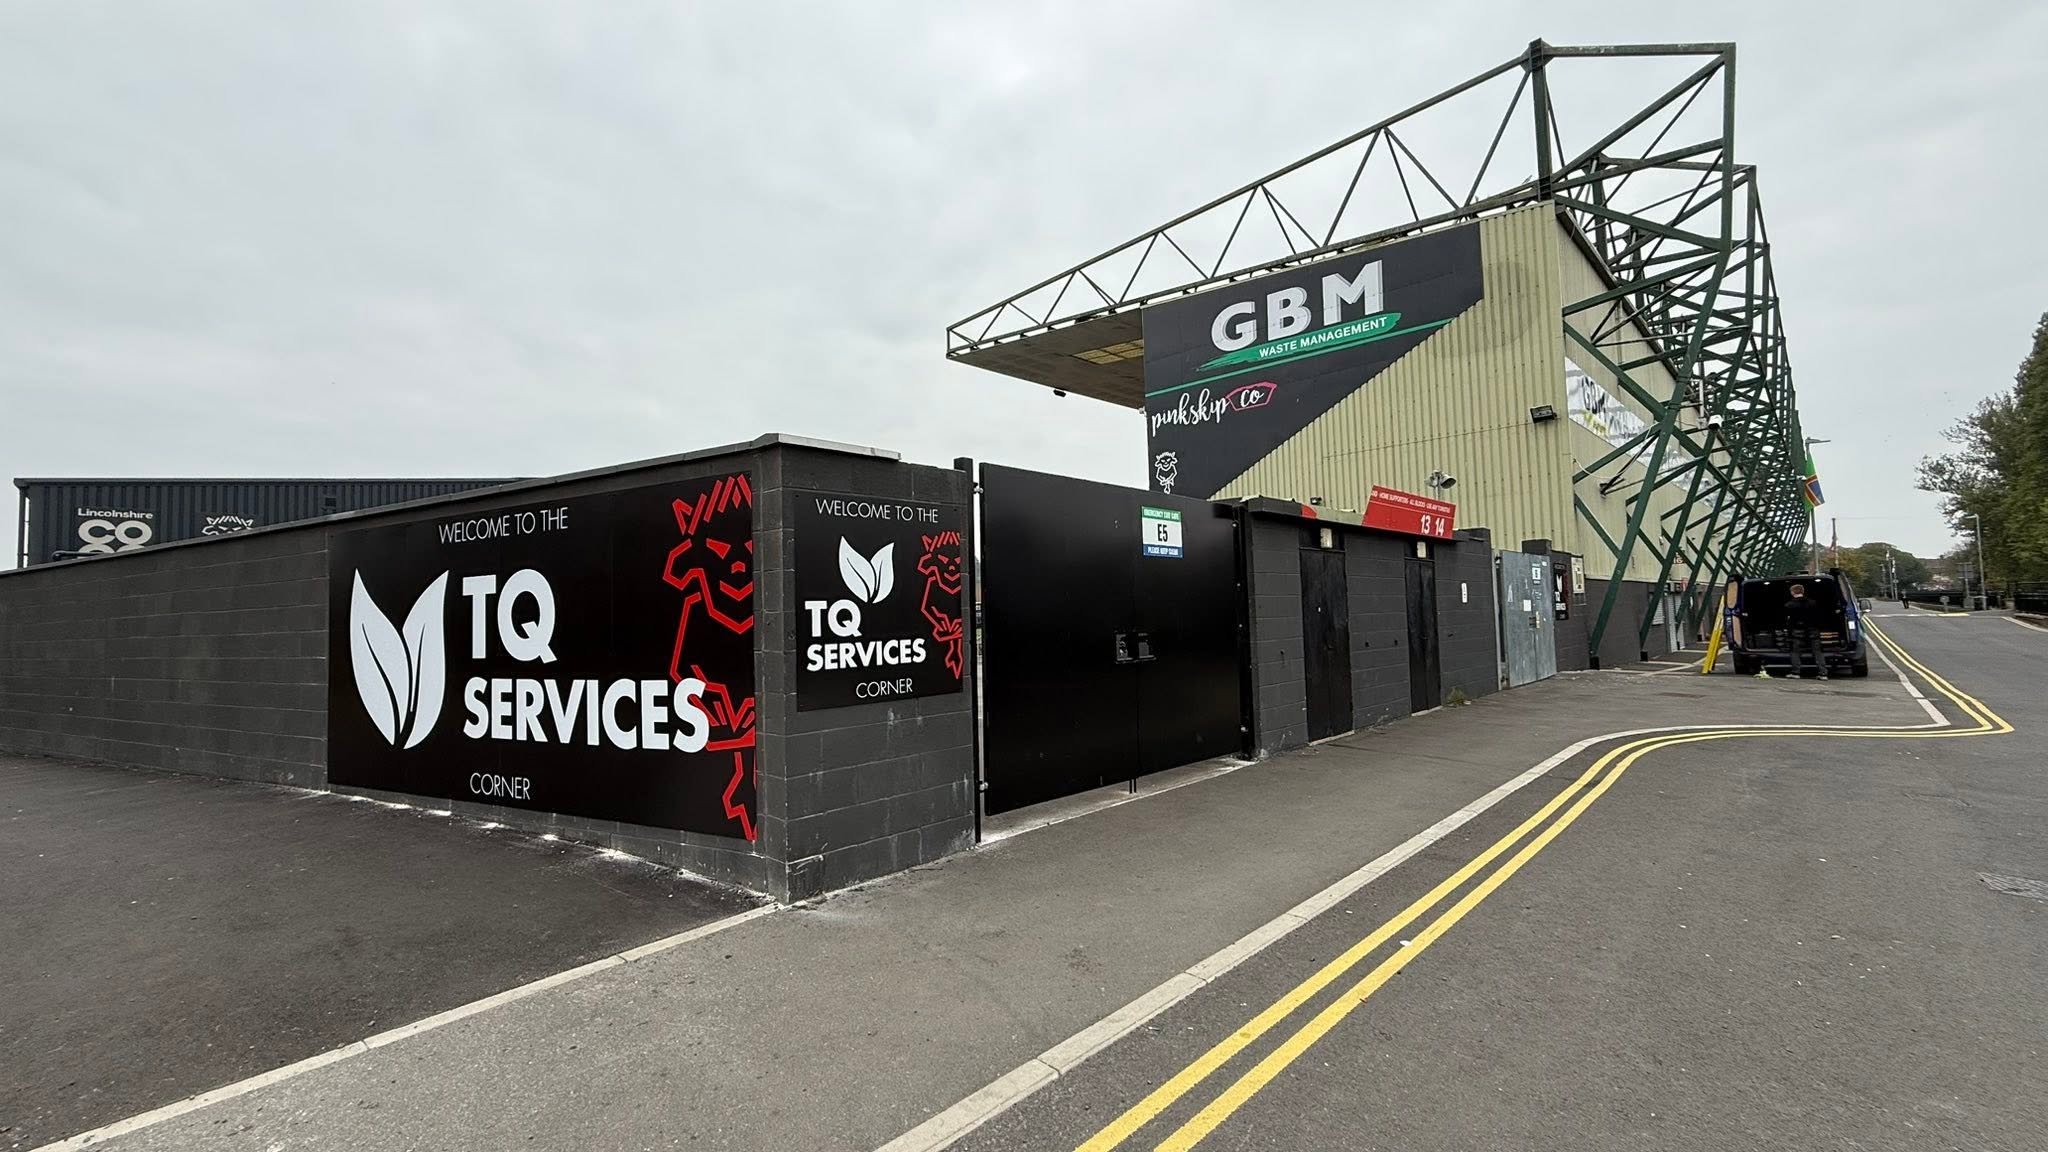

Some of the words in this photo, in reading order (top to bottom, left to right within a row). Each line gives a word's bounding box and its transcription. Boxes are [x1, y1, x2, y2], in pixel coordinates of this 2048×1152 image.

[1211, 259, 1385, 352] GBM
[1259, 340, 1298, 357] WASTE
[1299, 316, 1388, 349] MANAGEMENT
[77, 508, 154, 519] Lincolnshire
[438, 514, 509, 544] WELCOME
[514, 511, 536, 535] TO
[539, 507, 569, 531] THE
[815, 499, 891, 520] WELCOME
[894, 506, 914, 522] TO
[917, 508, 939, 524] THE
[1420, 514, 1432, 534] 13
[1435, 518, 1446, 536] 14
[78, 519, 153, 545] CO
[1157, 523, 1169, 542] E5
[462, 568, 557, 663] TQ
[804, 599, 862, 637] TQ
[806, 638, 927, 672] SERVICES
[855, 677, 913, 698] CORNER
[463, 676, 710, 753] SERVICES
[469, 772, 531, 800] CORNER
